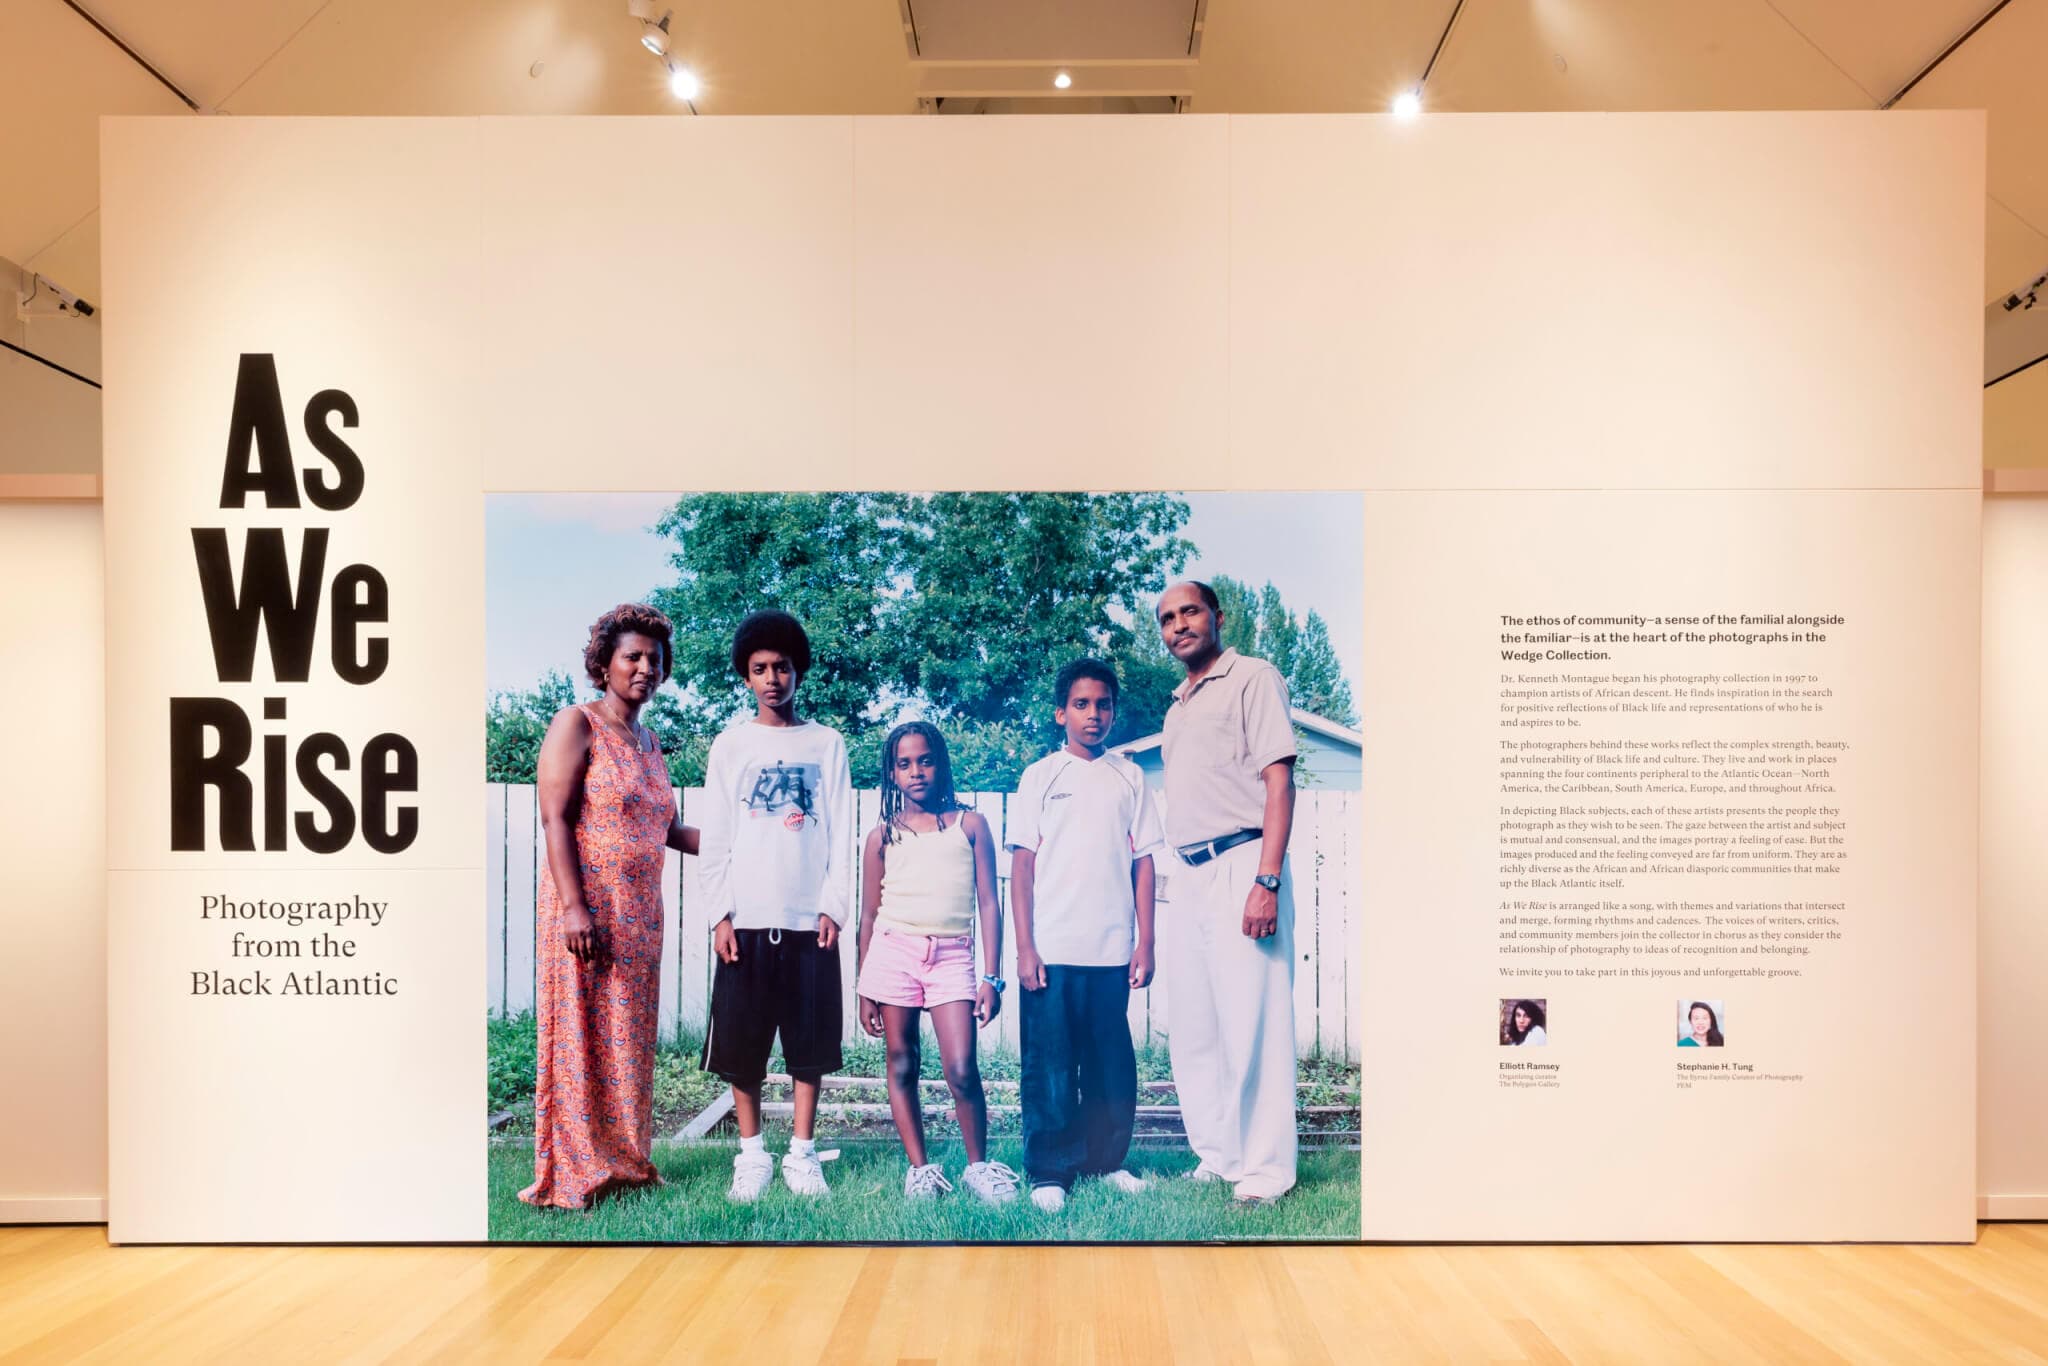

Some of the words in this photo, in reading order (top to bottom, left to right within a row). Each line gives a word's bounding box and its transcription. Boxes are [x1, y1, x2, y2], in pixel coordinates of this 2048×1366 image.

[220, 353, 364, 511] As
[191, 528, 388, 685] We
[1501, 615, 1524, 625] The
[1526, 615, 1560, 625] ethos
[1563, 615, 1576, 625] of
[1665, 617, 1700, 625] sense
[1702, 614, 1716, 625] of
[1717, 614, 1737, 625] the
[1740, 614, 1784, 625] familial
[1787, 614, 1844, 627] alongside
[1501, 632, 1521, 643] the
[1593, 632, 1607, 642] at
[1609, 632, 1630, 642] the
[1633, 632, 1667, 642] heart
[1670, 632, 1684, 642] of
[1685, 632, 1706, 642] the
[1709, 631, 1789, 645] photographs
[1792, 631, 1802, 642] in
[1805, 631, 1826, 642] the
[1501, 650, 1543, 663] Wedge
[1546, 650, 1611, 660] Collection.
[1501, 673, 1515, 683] Dr.
[1518, 673, 1559, 683] Kenneth
[1561, 673, 1610, 685] Montague
[1611, 673, 1641, 685] began
[1643, 673, 1658, 683] his
[1659, 673, 1721, 685] photography
[1723, 673, 1770, 682] collection
[1773, 673, 1782, 682] in
[1785, 675, 1806, 685] 1997
[1808, 674, 1818, 682] to
[1500, 688, 1548, 700] champion
[1550, 688, 1581, 697] artists
[1582, 688, 1594, 697] of
[1594, 688, 1631, 697] African
[1632, 688, 1672, 697] descent.
[1674, 688, 1688, 697] He
[1690, 688, 1715, 697] finds
[1717, 688, 1770, 700] inspiration
[1772, 687, 1782, 697] in
[1784, 687, 1800, 697] the
[1801, 687, 1832, 697] search
[1500, 703, 1515, 712] for
[1516, 703, 1554, 715] positive
[1556, 703, 1608, 712] reflections
[1609, 702, 1620, 712] of
[1622, 702, 1648, 712] Black
[1651, 702, 1667, 712] life
[1669, 702, 1687, 712] and
[1689, 702, 1764, 714] representations
[1765, 702, 1776, 712] of
[1777, 702, 1799, 712] who
[1800, 702, 1812, 711] he
[1815, 702, 1823, 711] is
[1499, 717, 1518, 726] and
[1519, 717, 1553, 729] aspires
[1554, 718, 1565, 726] to
[1567, 717, 1581, 726] be.
[1499, 740, 1519, 749] The
[1520, 740, 1588, 752] photographers
[1589, 739, 1622, 749] behind
[1624, 739, 1649, 749] these
[1650, 739, 1679, 749] works
[1681, 739, 1711, 749] reflect
[1713, 739, 1728, 748] the
[1729, 739, 1770, 751] complex
[1771, 739, 1814, 751] strength,
[1816, 739, 1850, 751] beauty,
[1500, 754, 1519, 763] and
[1519, 754, 1583, 766] vulnerability
[1582, 754, 1595, 763] of
[1596, 754, 1623, 763] Black
[1625, 754, 1642, 763] life
[1643, 754, 1661, 763] and
[1663, 754, 1700, 763] culture.
[1702, 754, 1726, 766] They
[1728, 754, 1746, 763] live
[1748, 754, 1766, 763] and
[1768, 754, 1793, 763] work
[1795, 754, 1805, 763] in
[1806, 754, 1837, 766] places
[170, 697, 418, 854] Rise
[1500, 769, 1545, 781] spanning
[1546, 769, 1563, 778] the
[1564, 768, 1586, 778] four
[1585, 768, 1638, 778] continents
[1639, 768, 1689, 780] peripheral
[1691, 769, 1701, 778] to
[1703, 768, 1720, 778] the
[1721, 768, 1760, 778] Atlantic
[1500, 783, 1543, 794] America,
[1544, 783, 1561, 792] the
[1560, 783, 1613, 794] Caribbean,
[1614, 783, 1643, 792] South
[1645, 783, 1687, 794] America,
[1690, 783, 1727, 795] Europe,
[1728, 783, 1747, 792] and
[1749, 783, 1802, 795] throughout
[1804, 783, 1836, 792] Africa.
[1500, 881, 1512, 890] up
[1513, 878, 1529, 887] the
[1531, 878, 1557, 887] Black
[1559, 878, 1597, 887] Atlantic
[1599, 878, 1624, 887] itself.
[201, 894, 388, 927] Photography
[232, 932, 301, 957] from
[310, 932, 356, 958] the
[1499, 944, 1556, 956] relationship
[1557, 944, 1569, 953] of
[1569, 944, 1631, 956] photography
[1632, 945, 1643, 953] to
[1645, 944, 1670, 953] ideas
[1670, 944, 1682, 953] of
[1683, 944, 1738, 956] recognition
[1740, 944, 1758, 953] and
[1760, 944, 1810, 956] belonging.
[1499, 966, 1514, 976] We
[1516, 967, 1543, 976] invite
[1544, 969, 1562, 979] you
[1564, 968, 1574, 976] to
[1575, 967, 1596, 976] take
[1598, 968, 1617, 979] part
[1619, 967, 1629, 976] in
[1631, 967, 1650, 976] this
[1651, 967, 1681, 979] joyous
[1683, 967, 1701, 976] and
[1703, 967, 1766, 979] unforgettable
[1768, 969, 1802, 979] groove.
[191, 970, 272, 996] Black
[280, 970, 398, 996] Atlantic
[1499, 1062, 1525, 1070] Elliott
[1526, 1062, 1560, 1071] Ramsey
[1677, 1062, 1719, 1072] Stephanie
[1733, 1063, 1753, 1072] Tung
